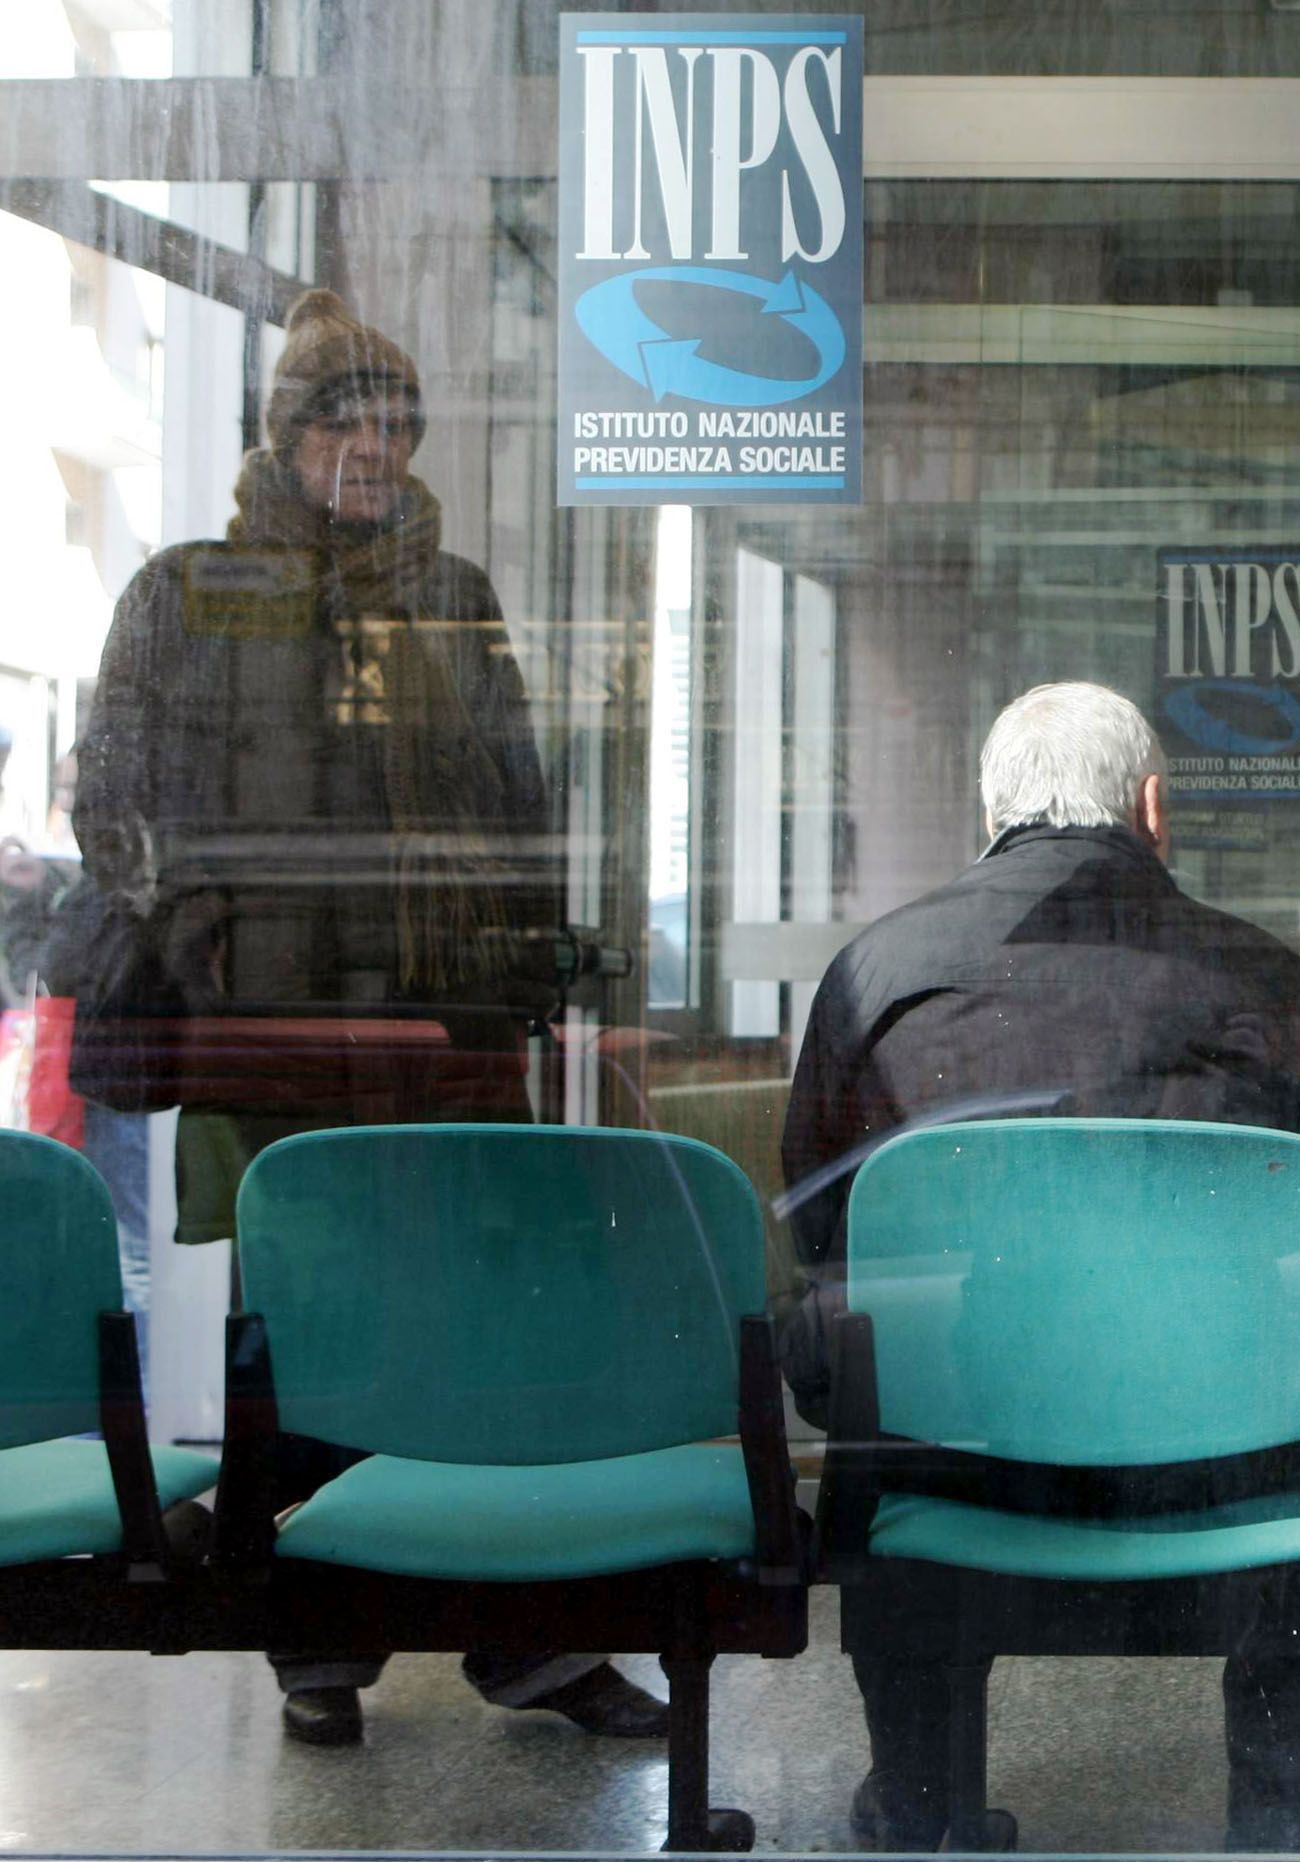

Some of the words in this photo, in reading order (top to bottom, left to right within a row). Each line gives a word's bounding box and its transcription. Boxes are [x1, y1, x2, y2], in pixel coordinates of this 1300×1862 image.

[575, 46, 846, 263] INPS
[574, 412, 688, 438] ISTITUTO
[698, 412, 846, 438] NAZIONALE
[574, 447, 732, 473] PREVIDENZA
[739, 447, 846, 473] SOCIALE
[1167, 757, 1224, 772] STITUTO
